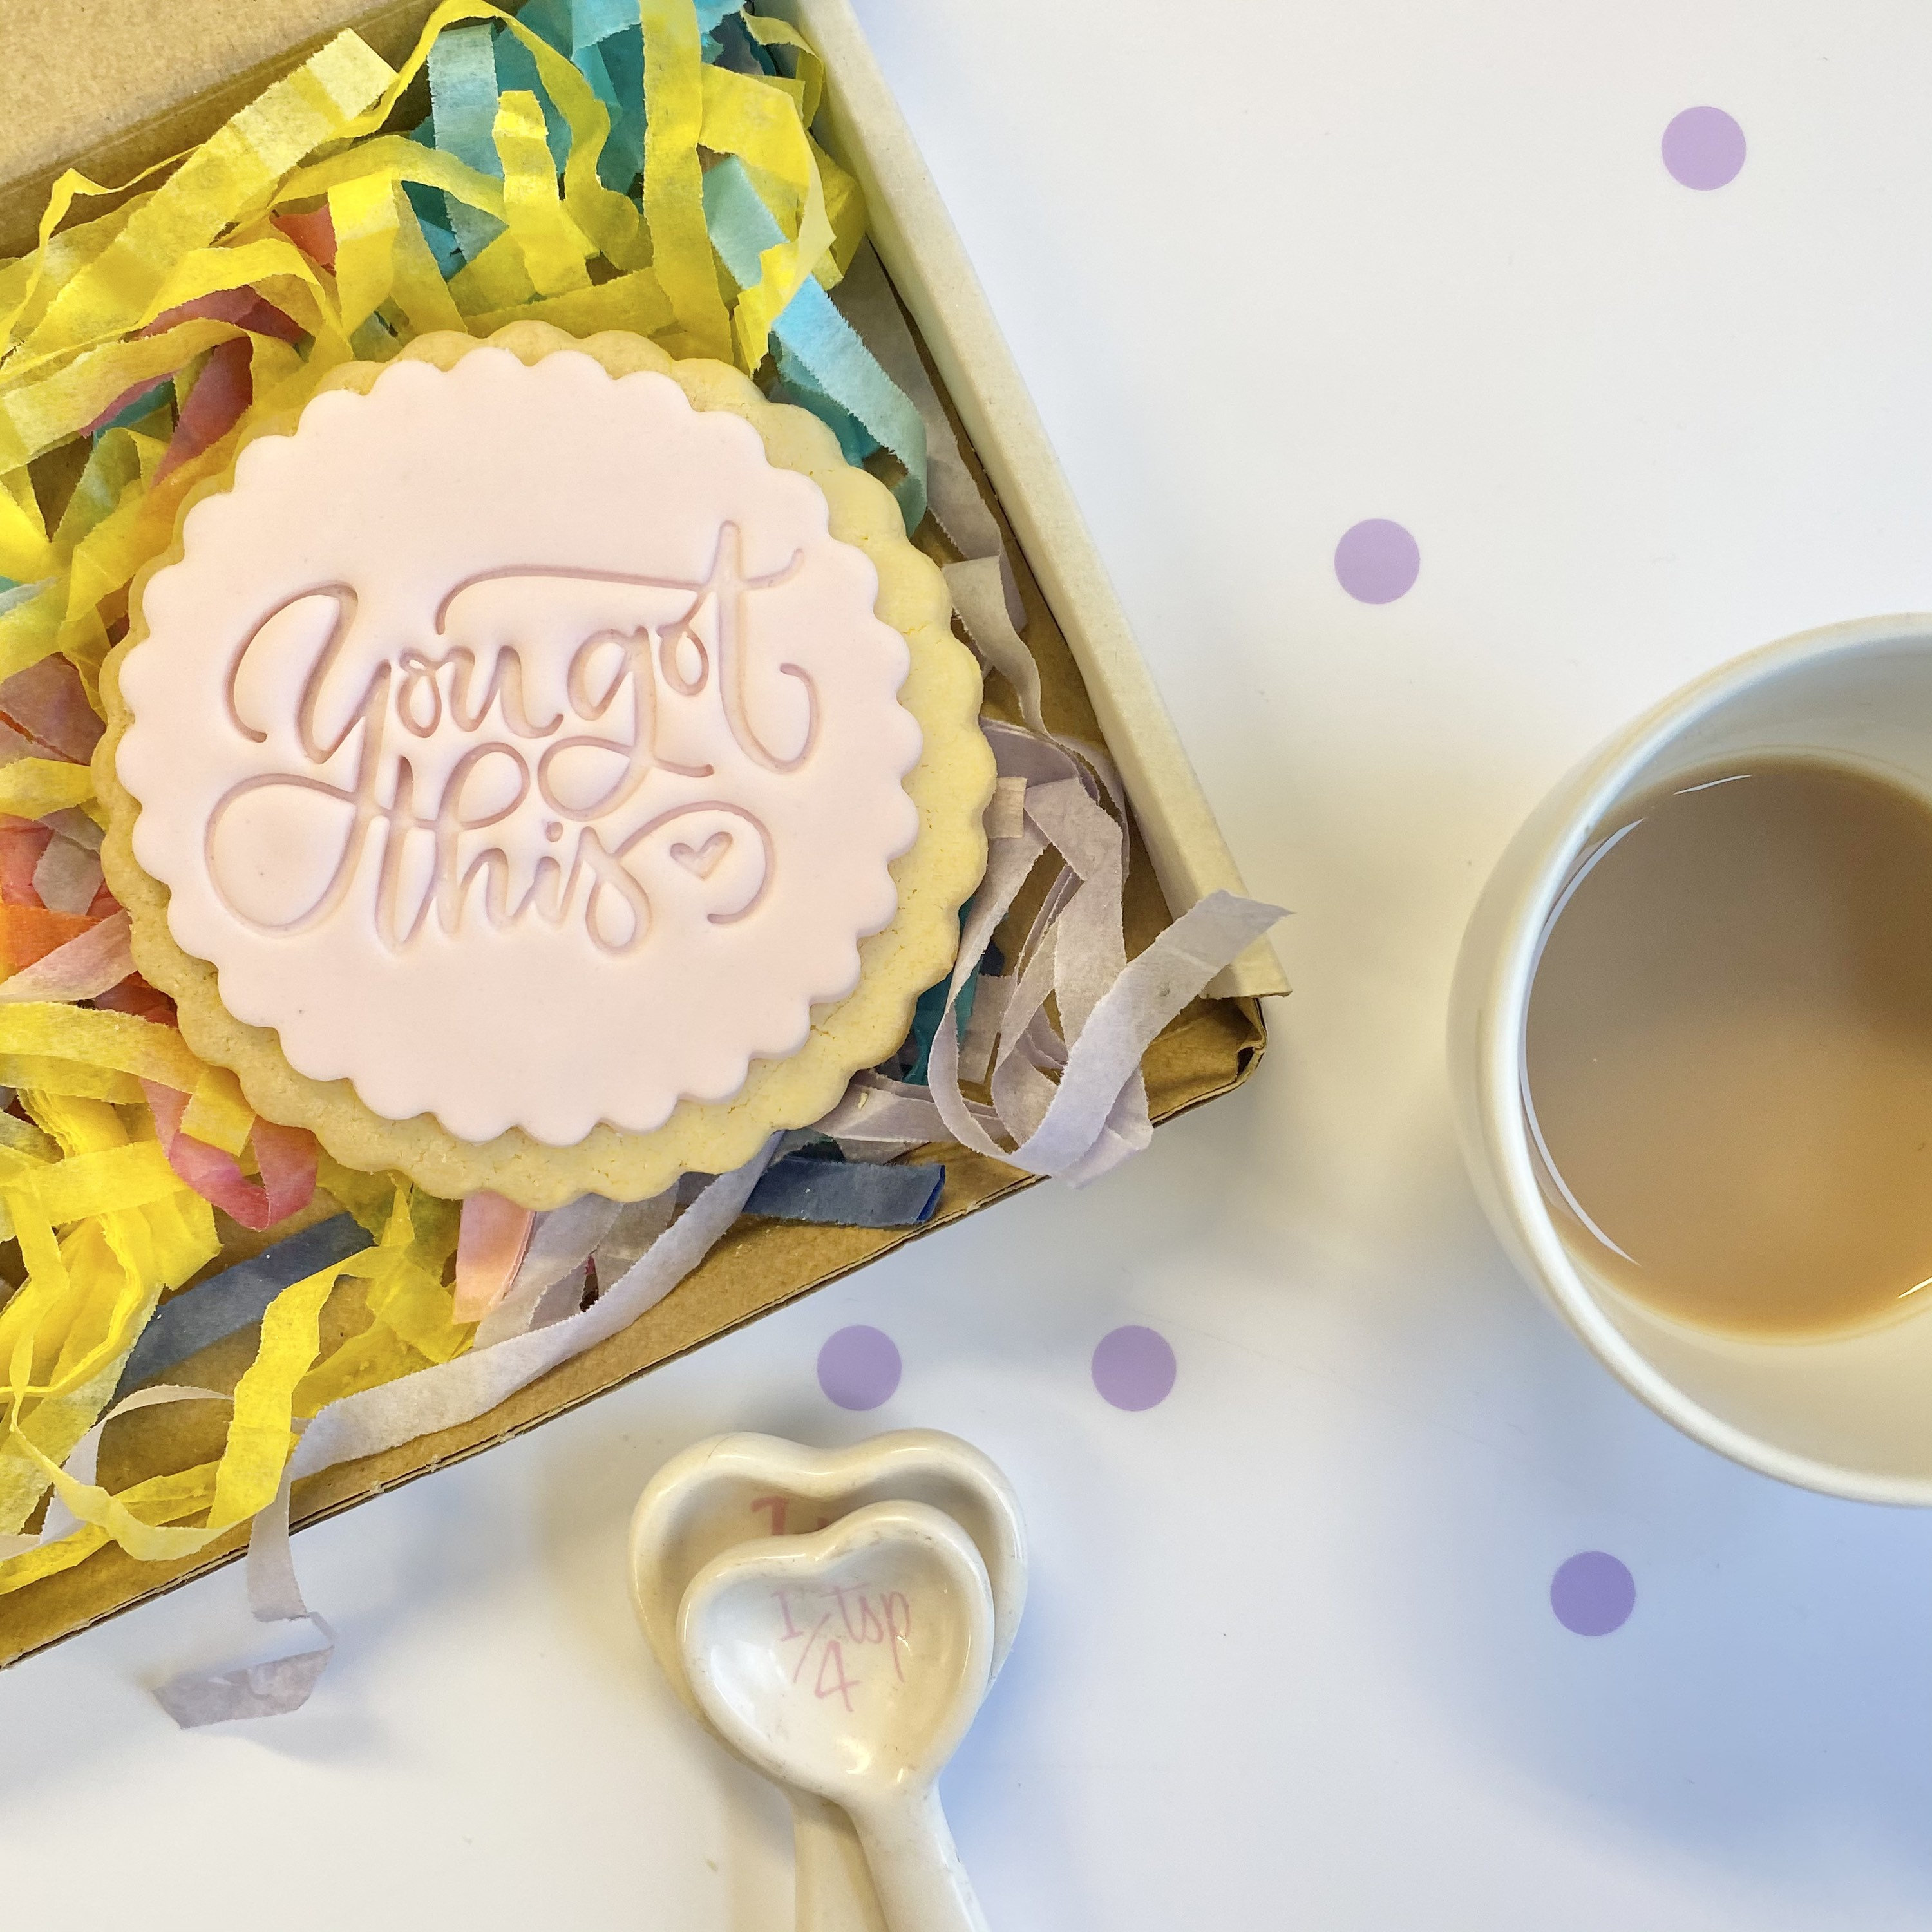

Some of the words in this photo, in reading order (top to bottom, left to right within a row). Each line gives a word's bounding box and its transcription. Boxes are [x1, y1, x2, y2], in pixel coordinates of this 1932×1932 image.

[204, 582, 564, 938] You
[435, 520, 820, 822] got
[374, 742, 775, 955] this
[820, 1582, 911, 1683] tsp
